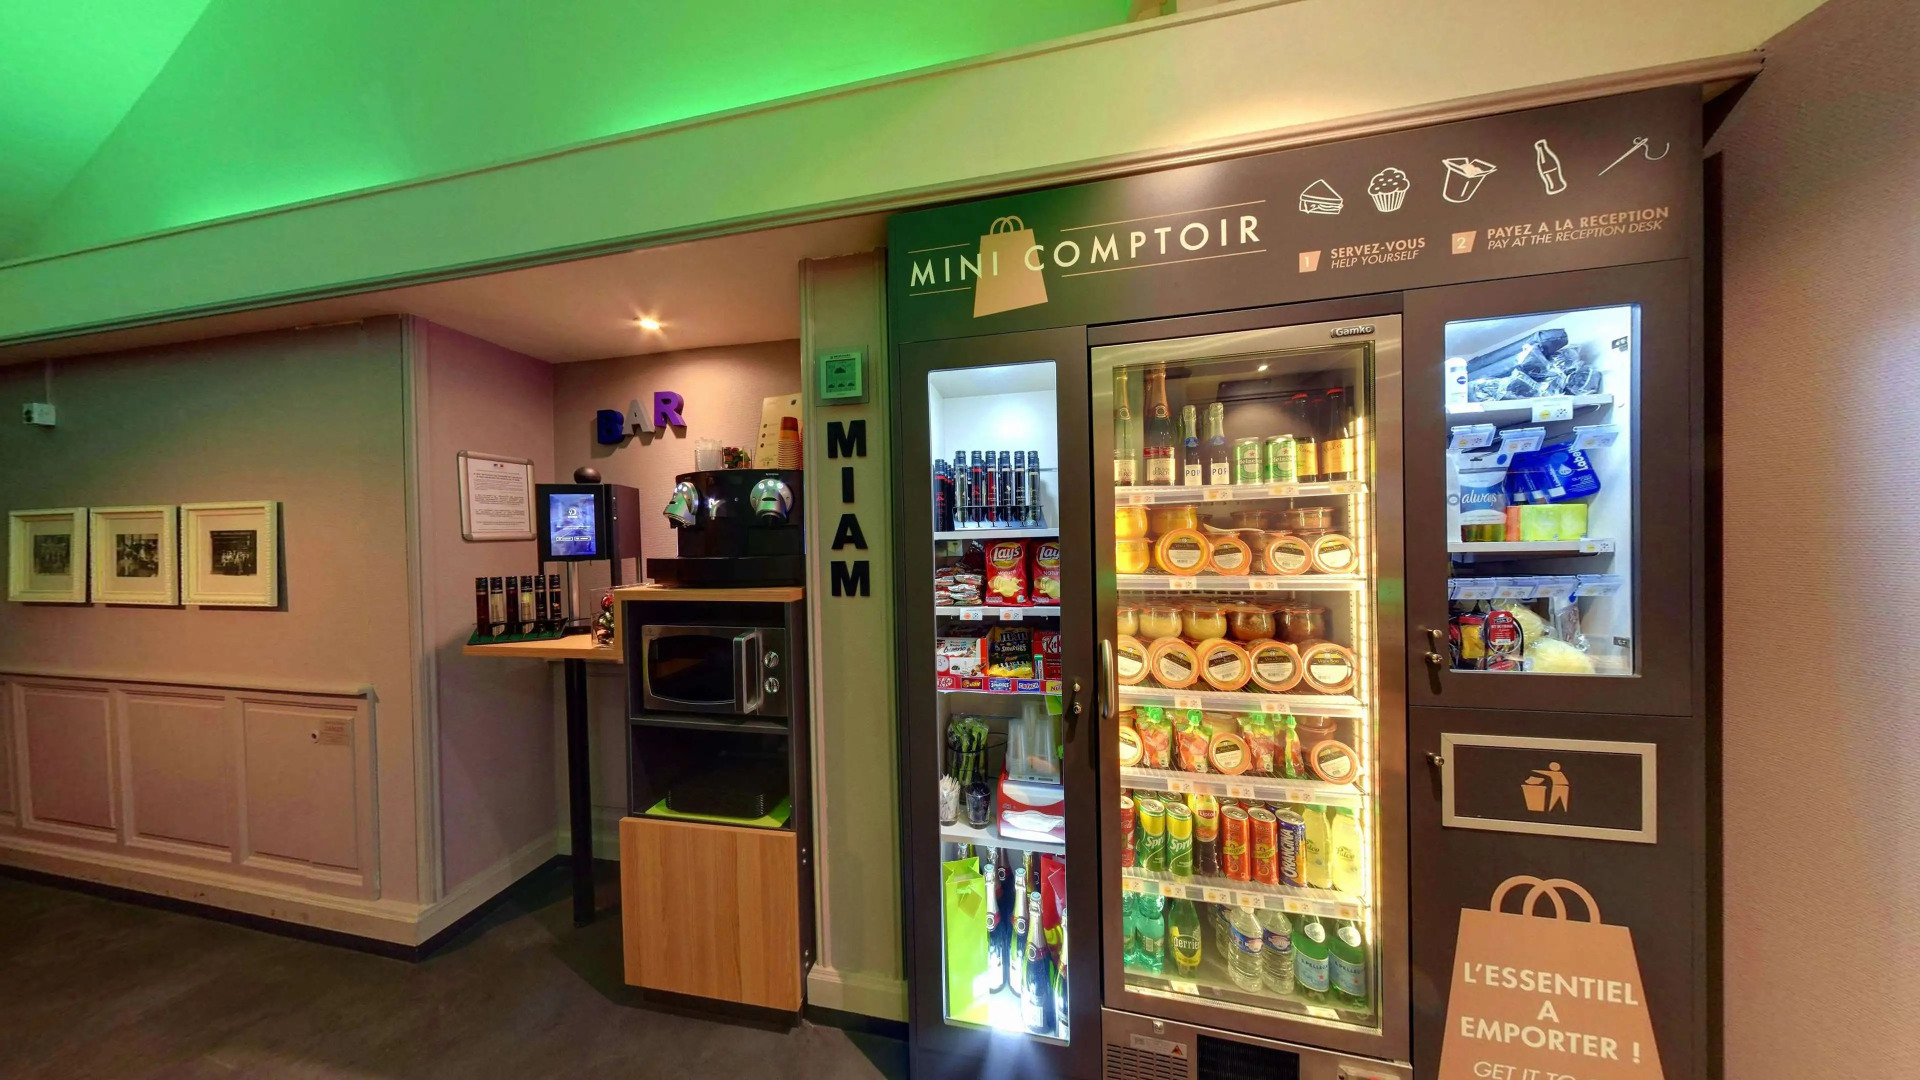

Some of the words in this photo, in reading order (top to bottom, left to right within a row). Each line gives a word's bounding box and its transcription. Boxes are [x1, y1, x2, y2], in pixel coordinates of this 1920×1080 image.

[1330, 237, 1426, 259] SERVEZ-VOUS
[1456, 237, 1466, 249] 2
[1487, 223, 1532, 239] PAYEZ
[1538, 222, 1549, 233] A
[1555, 218, 1574, 231] LA
[1580, 206, 1669, 228] RECEPTION
[1487, 239, 1509, 250] PAY
[1511, 236, 1527, 247] AT
[1530, 233, 1552, 245] THE
[1555, 225, 1626, 242] RECEPTION
[1628, 219, 1664, 233] DESK
[910, 251, 998, 286] MINI
[1024, 215, 1260, 271] COMPTOIR
[1330, 257, 1358, 269] HELP
[1361, 249, 1420, 266] YOURSELF
[597, 391, 688, 445] BAR
[827, 419, 870, 597] MIAM
[1280, 828, 1298, 878] ORANGINA
[1464, 961, 1639, 1006] L'ESSENTIEL
[1536, 999, 1560, 1024] A
[1460, 1015, 1619, 1061] EMPORTER
[1631, 1041, 1642, 1065] !
[1473, 1060, 1517, 1080] GET
